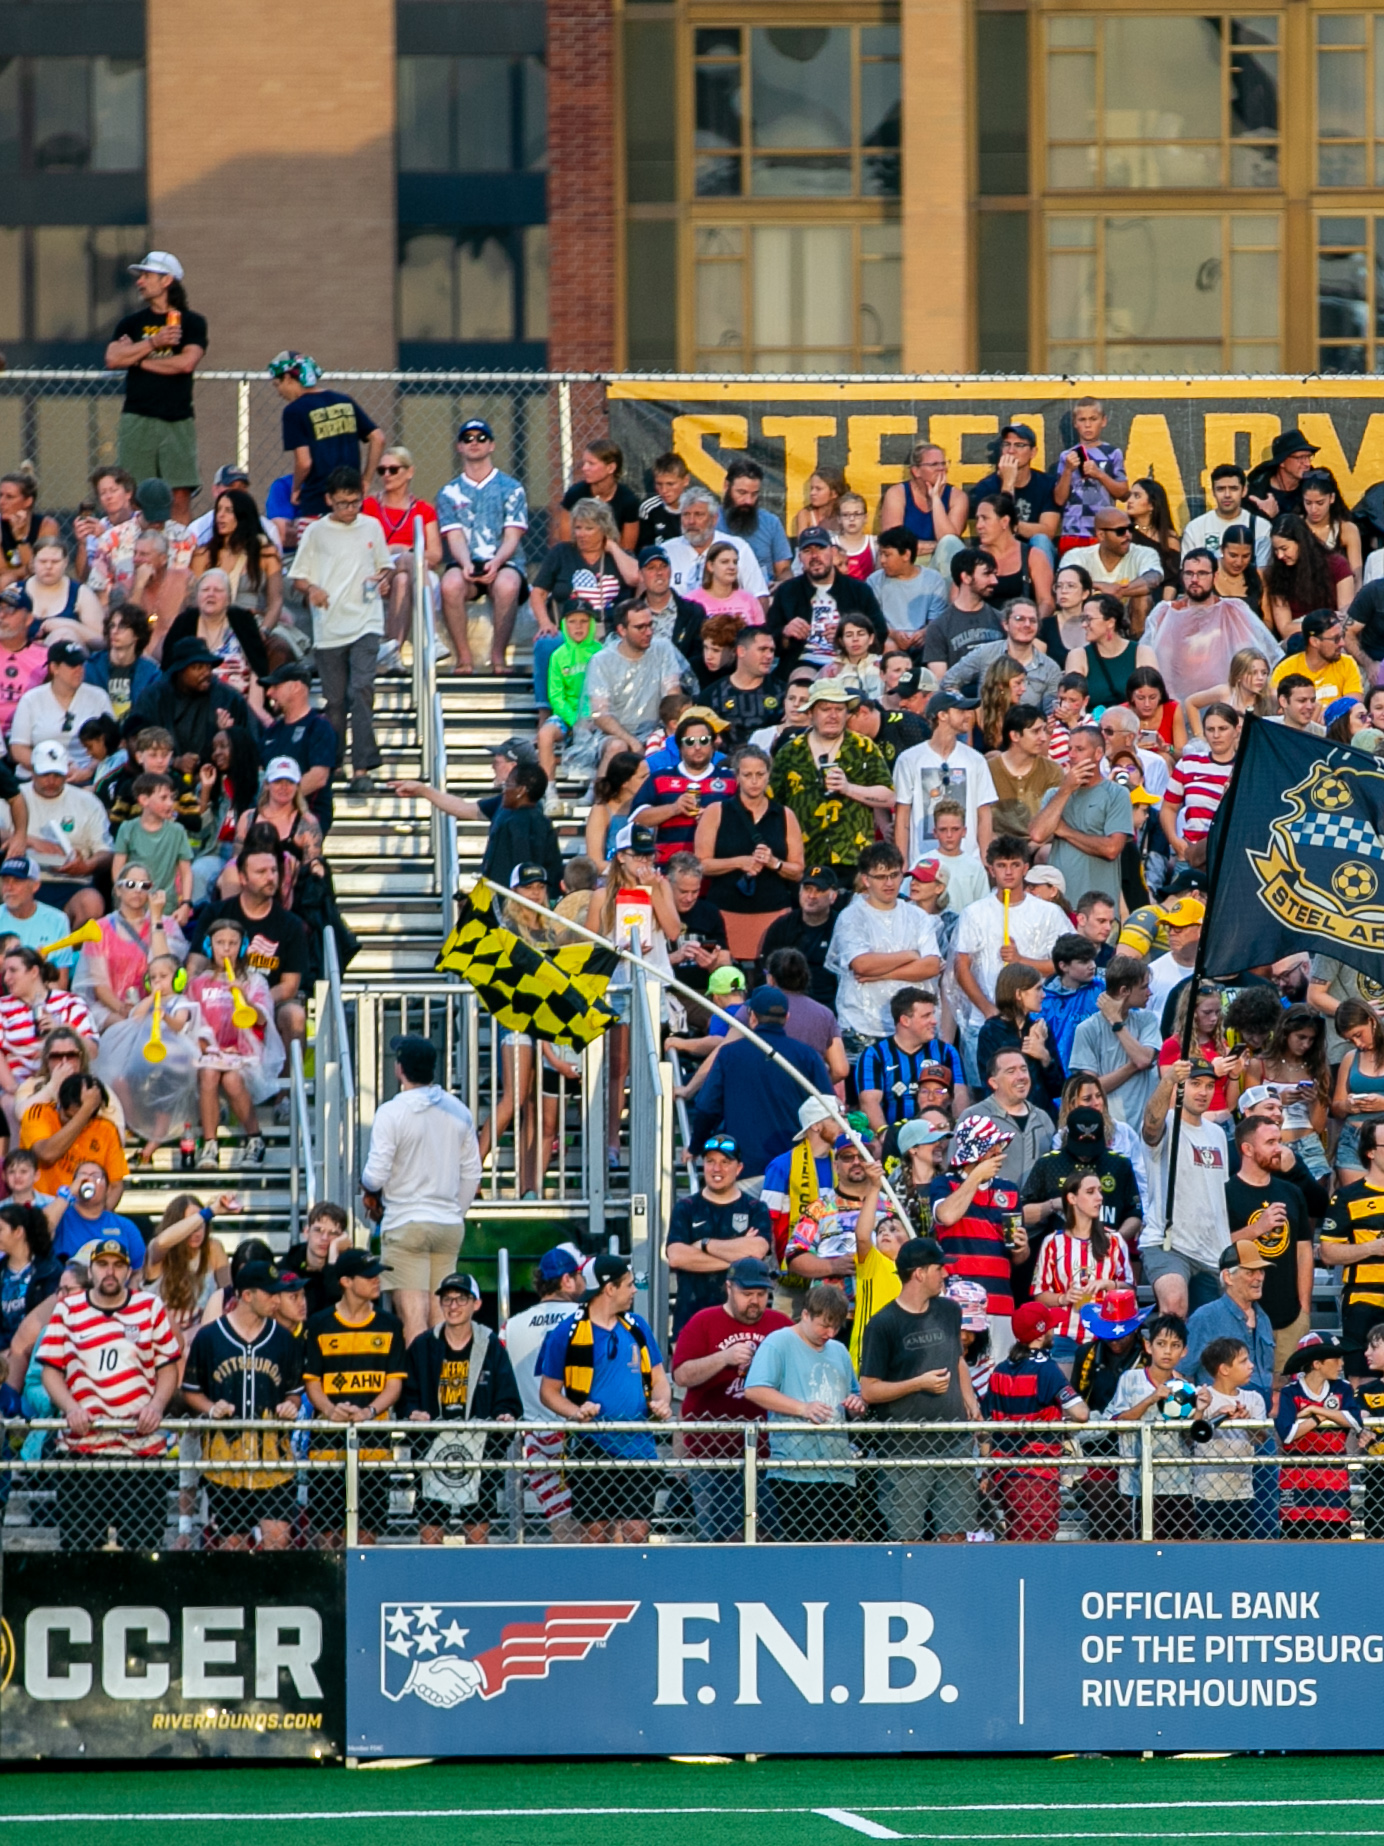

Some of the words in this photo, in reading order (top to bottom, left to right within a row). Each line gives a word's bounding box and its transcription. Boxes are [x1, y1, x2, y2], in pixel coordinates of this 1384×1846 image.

[1271, 884, 1337, 932] STEEL
[529, 1313, 566, 1327] ADAMS
[718, 1333, 751, 1351] EAGLES
[98, 1348, 119, 1372] 10
[213, 1356, 284, 1387] PITTSBURGH
[350, 1374, 382, 1389] AHN
[1082, 1592, 1222, 1620] OFFICIAL
[1231, 1592, 1321, 1620] BANK
[653, 1602, 959, 1705] F.N.B.
[1082, 1636, 1124, 1663] OF
[1132, 1636, 1196, 1663] THE
[1082, 1680, 1318, 1707] RIVERHOUNDS
[152, 1713, 323, 1731] RIVERHOUNDS.COM
